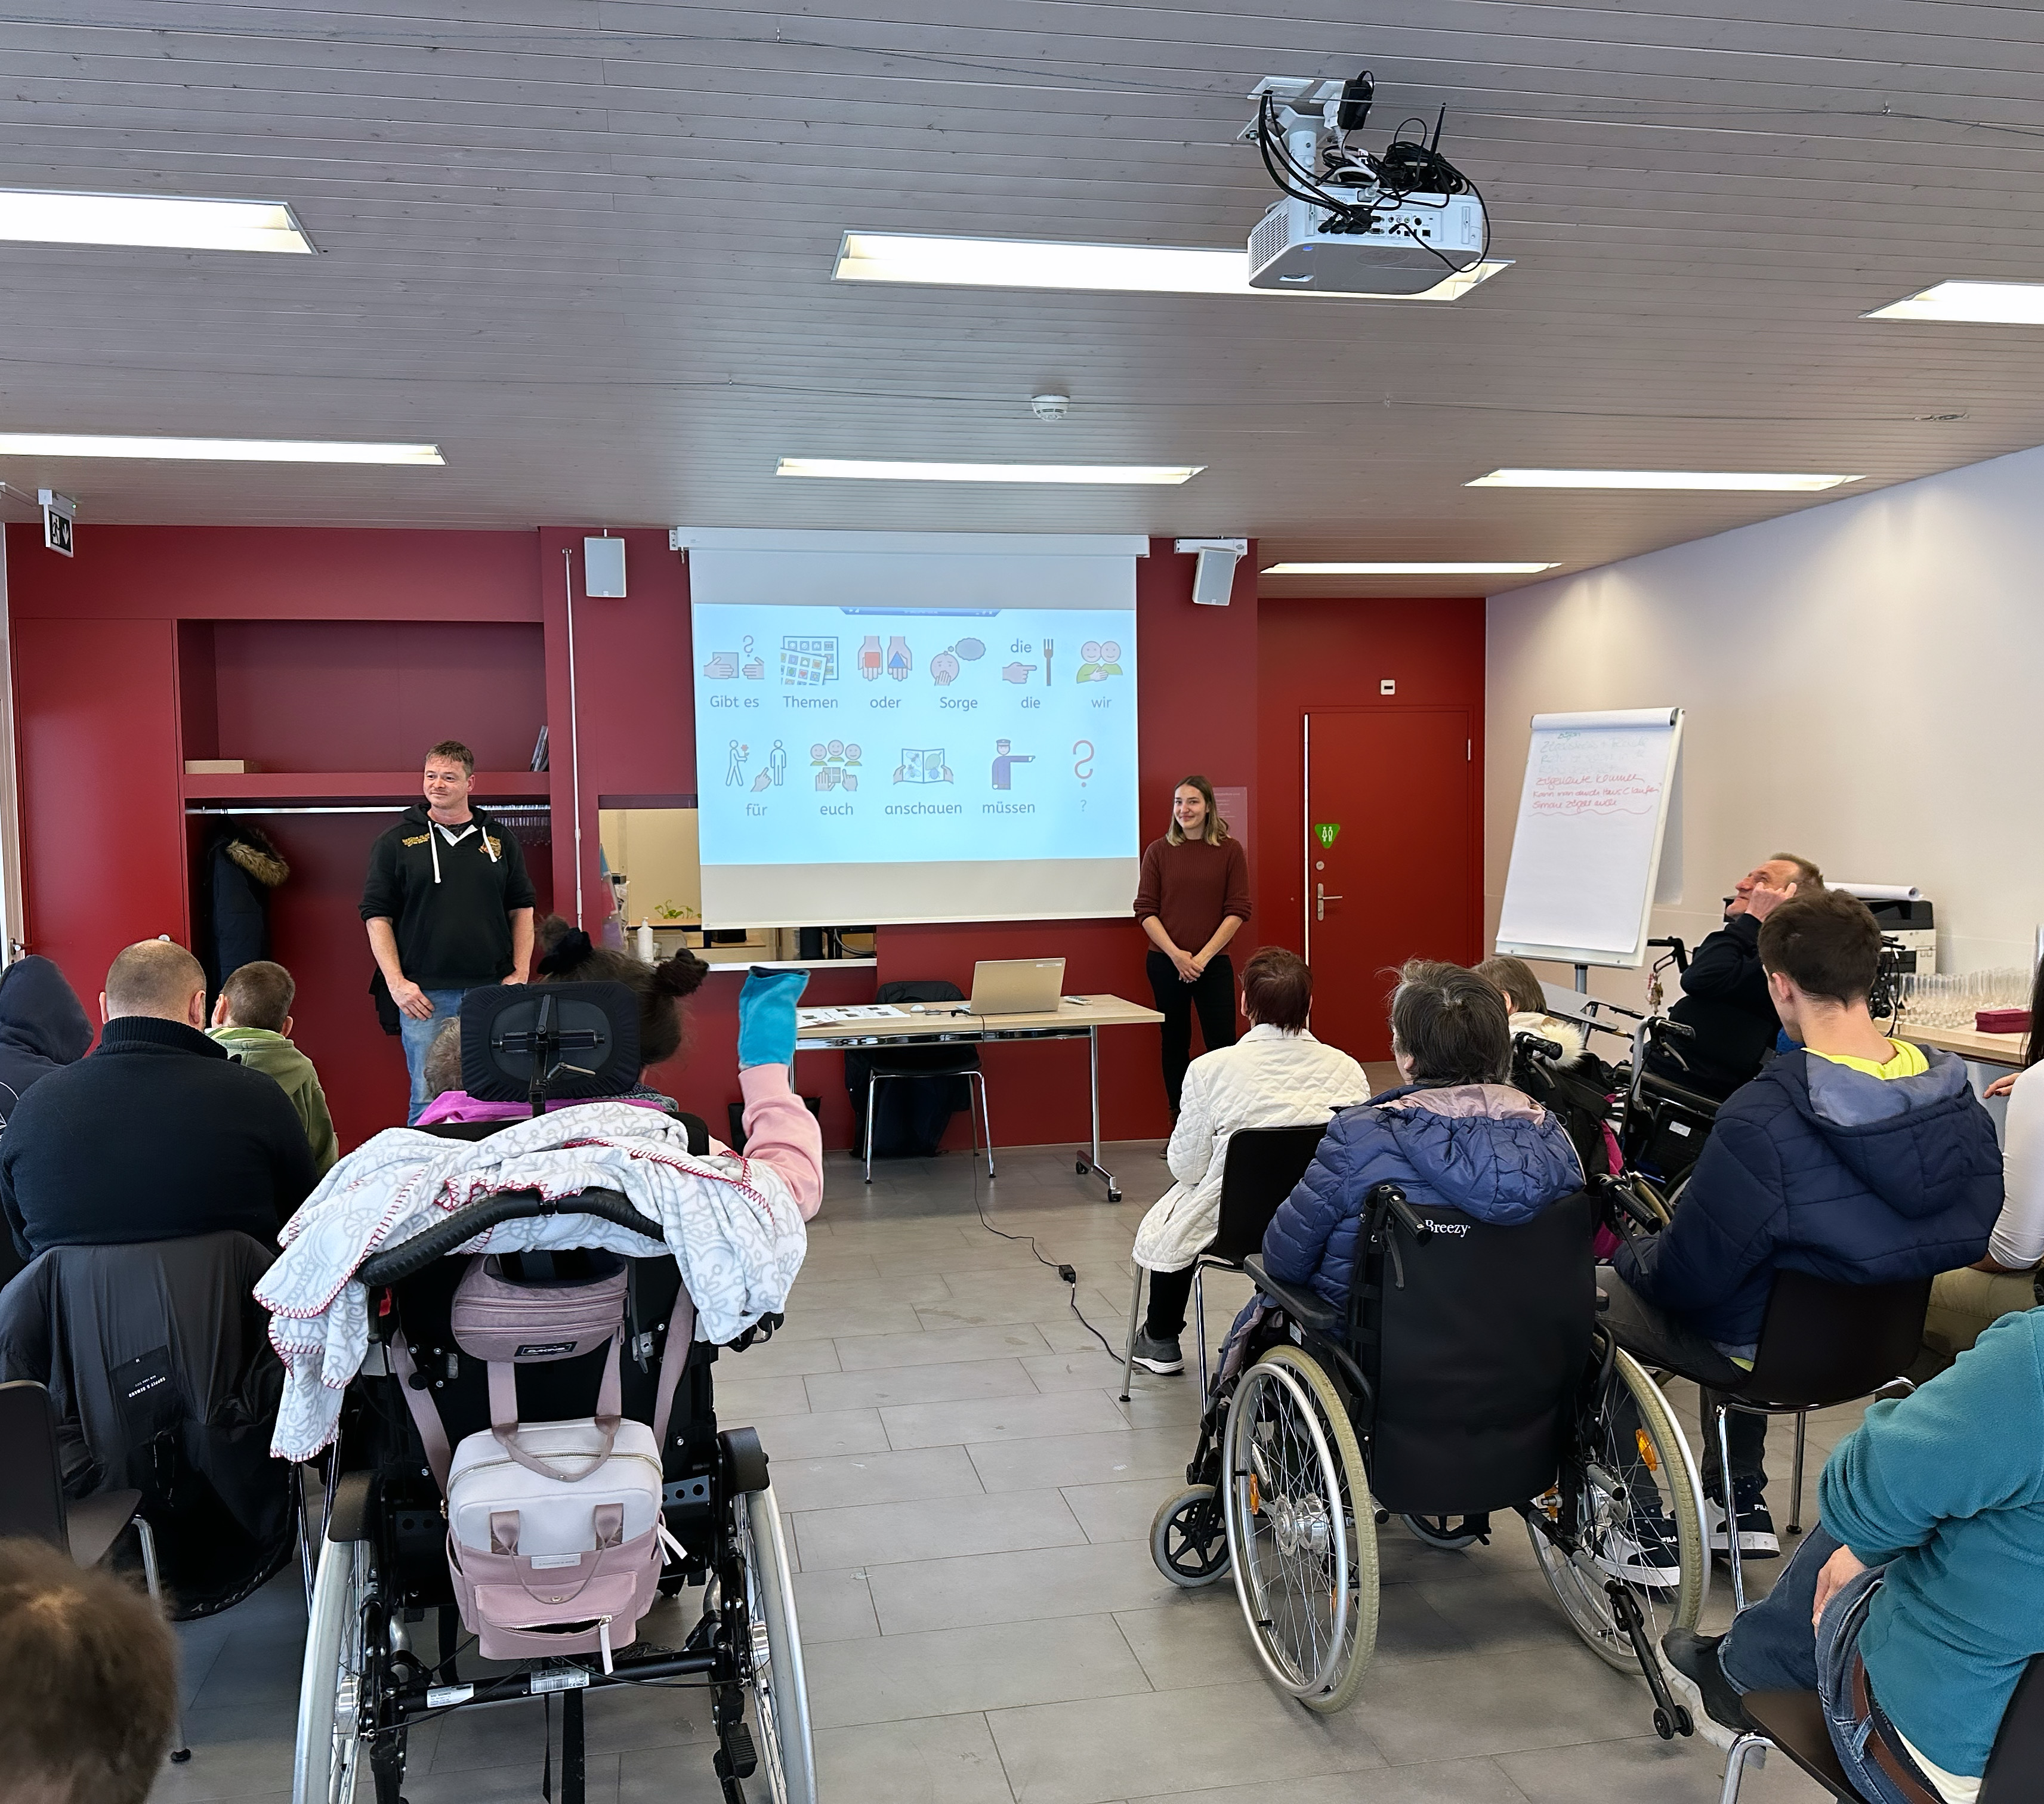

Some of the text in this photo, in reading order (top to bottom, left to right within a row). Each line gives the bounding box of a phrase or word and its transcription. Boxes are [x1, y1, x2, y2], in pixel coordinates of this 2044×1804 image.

[1010, 638, 1032, 653] die
[710, 695, 1112, 712] Gibt es Themen oder Sorge die wir
[745, 799, 1087, 816] für euch anschauen müssen ?
[1425, 1219, 1468, 1237] Breezy
